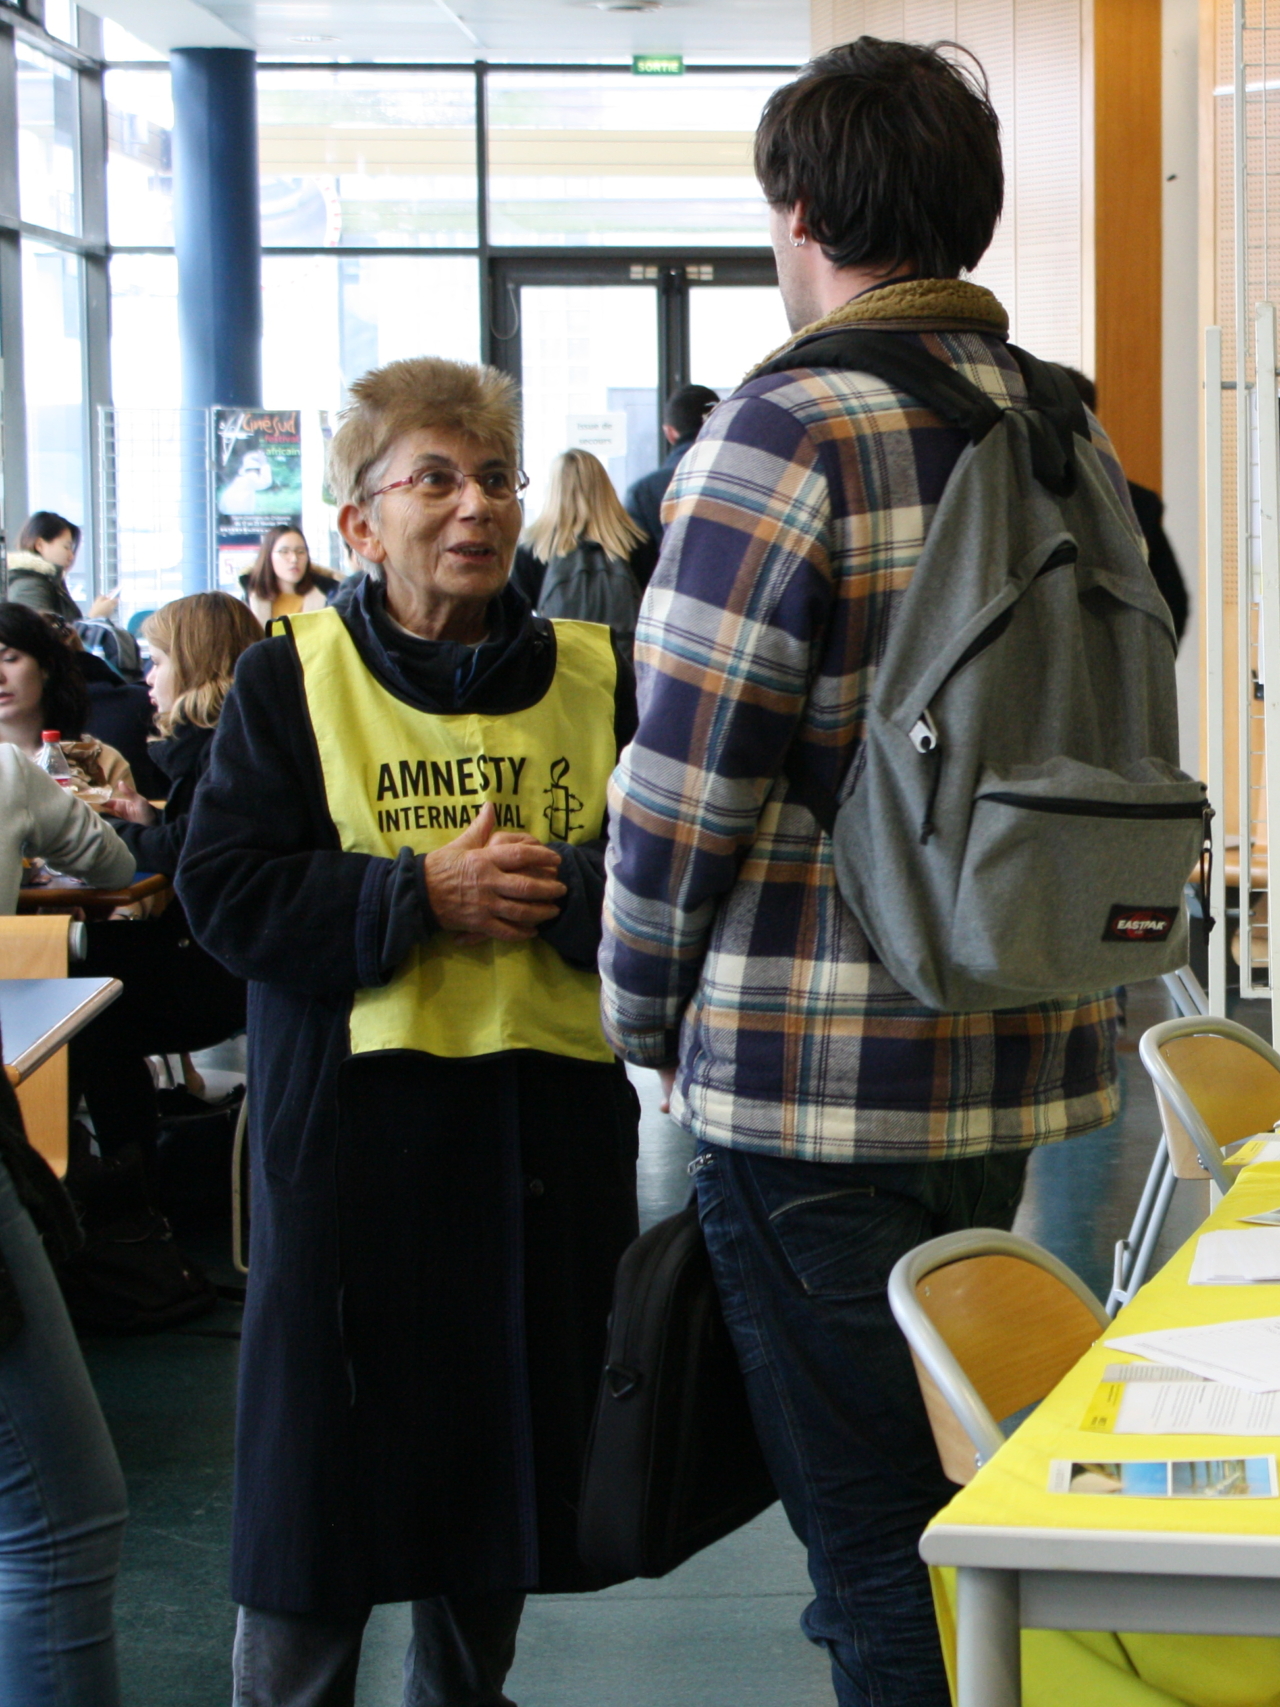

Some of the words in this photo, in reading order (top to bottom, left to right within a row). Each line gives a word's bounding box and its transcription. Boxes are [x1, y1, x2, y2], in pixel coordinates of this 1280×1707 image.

[638, 61, 679, 72] SORTIE
[376, 754, 526, 802] AMNESTY
[377, 803, 525, 834] INTERNATNAL
[1117, 919, 1167, 930] EASTPAK
